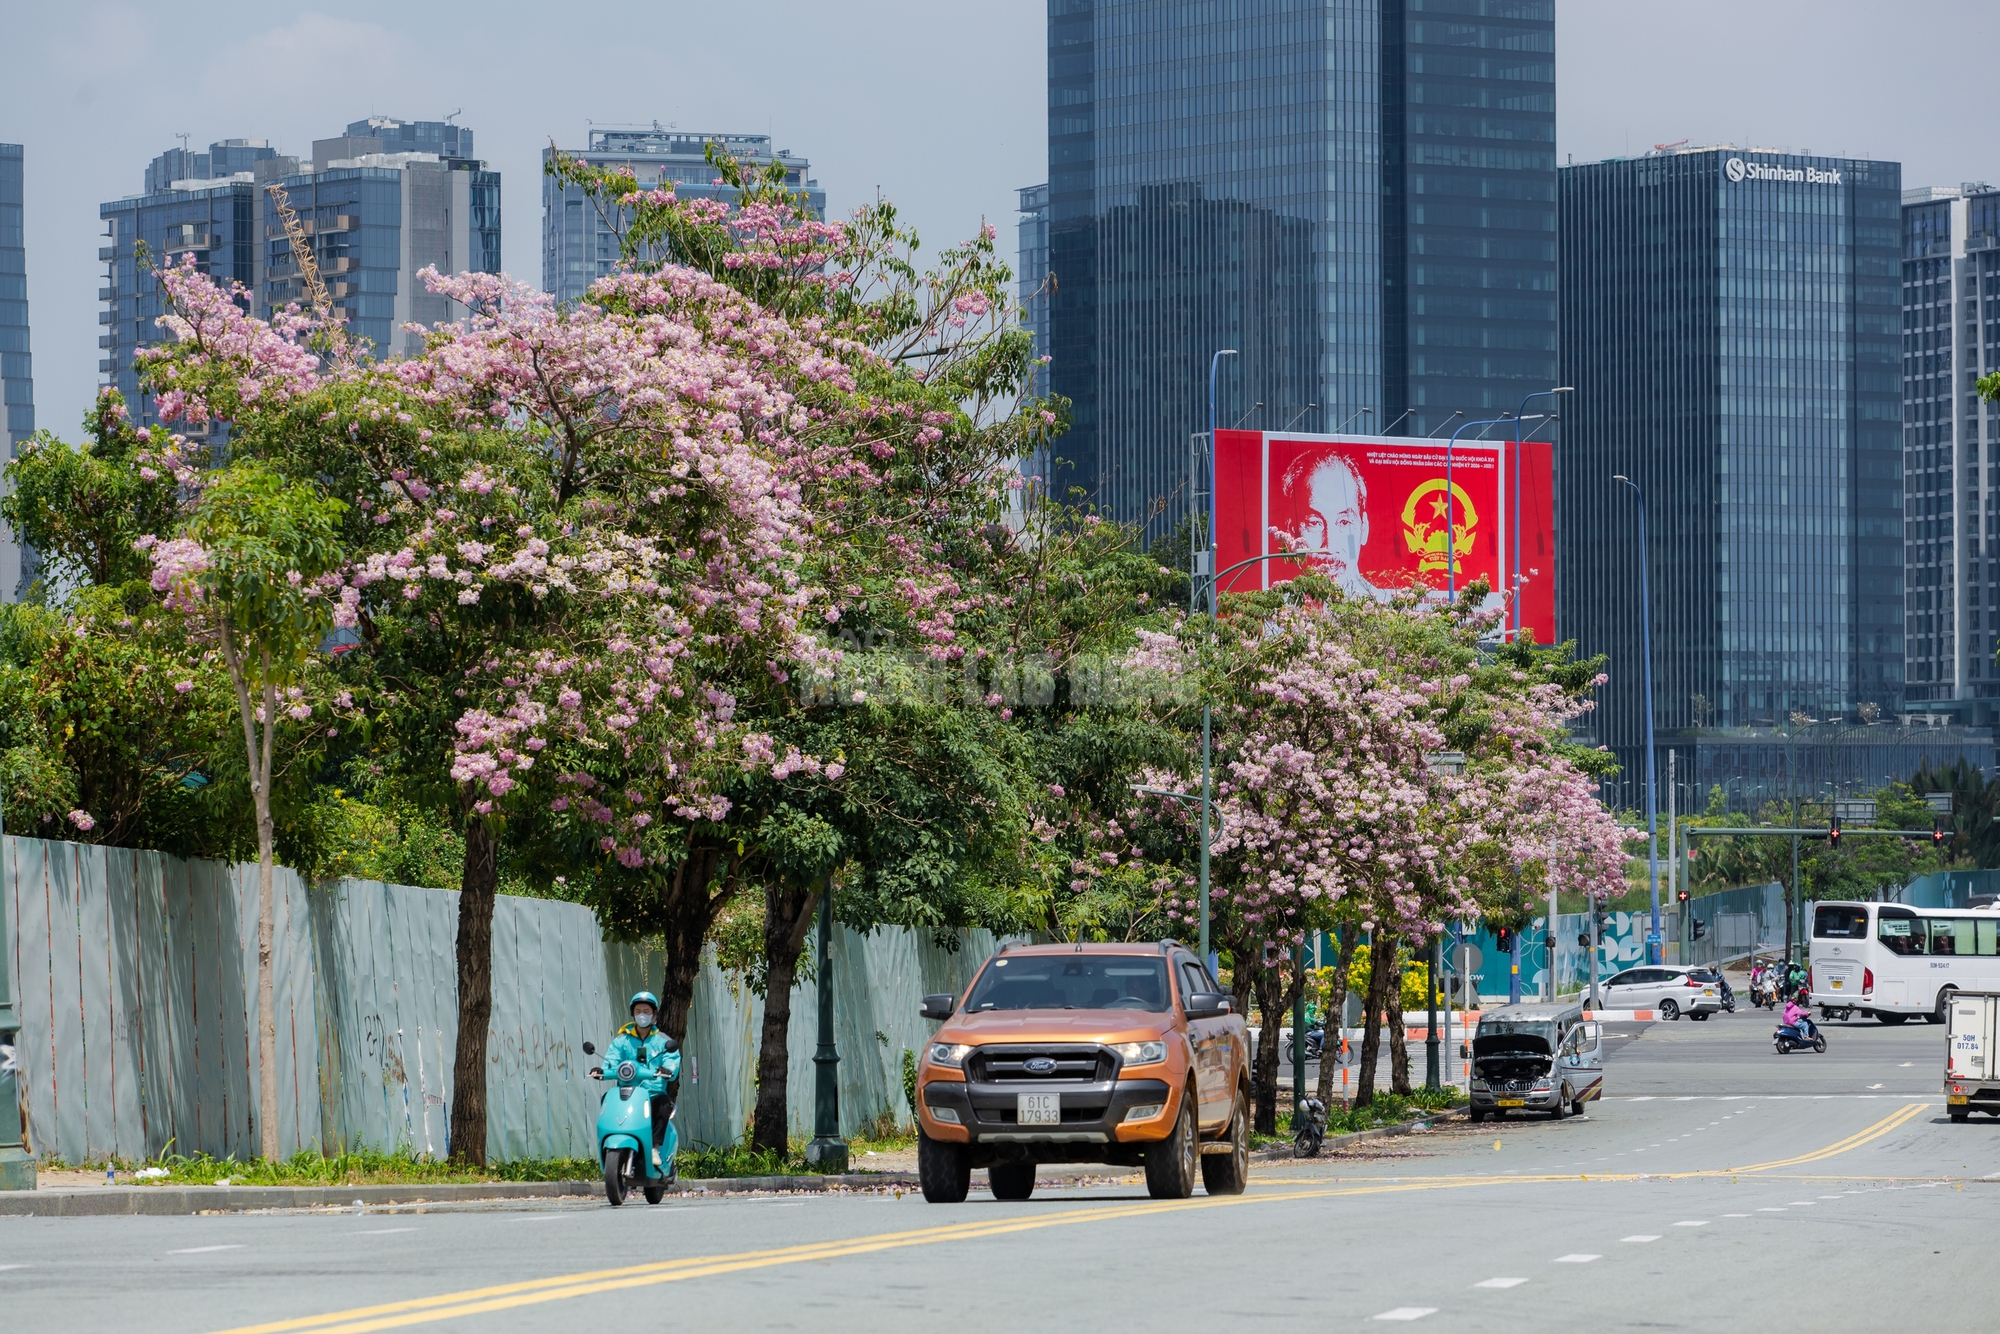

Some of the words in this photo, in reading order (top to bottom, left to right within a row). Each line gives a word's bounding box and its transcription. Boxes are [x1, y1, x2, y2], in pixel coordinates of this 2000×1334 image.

[1746, 162, 1804, 182] Shinhan
[1806, 166, 1842, 185] Bank
[1030, 1061, 1049, 1070] Ford
[1028, 1096, 1050, 1109] 61C
[1018, 1110, 1059, 1123] 179.33
